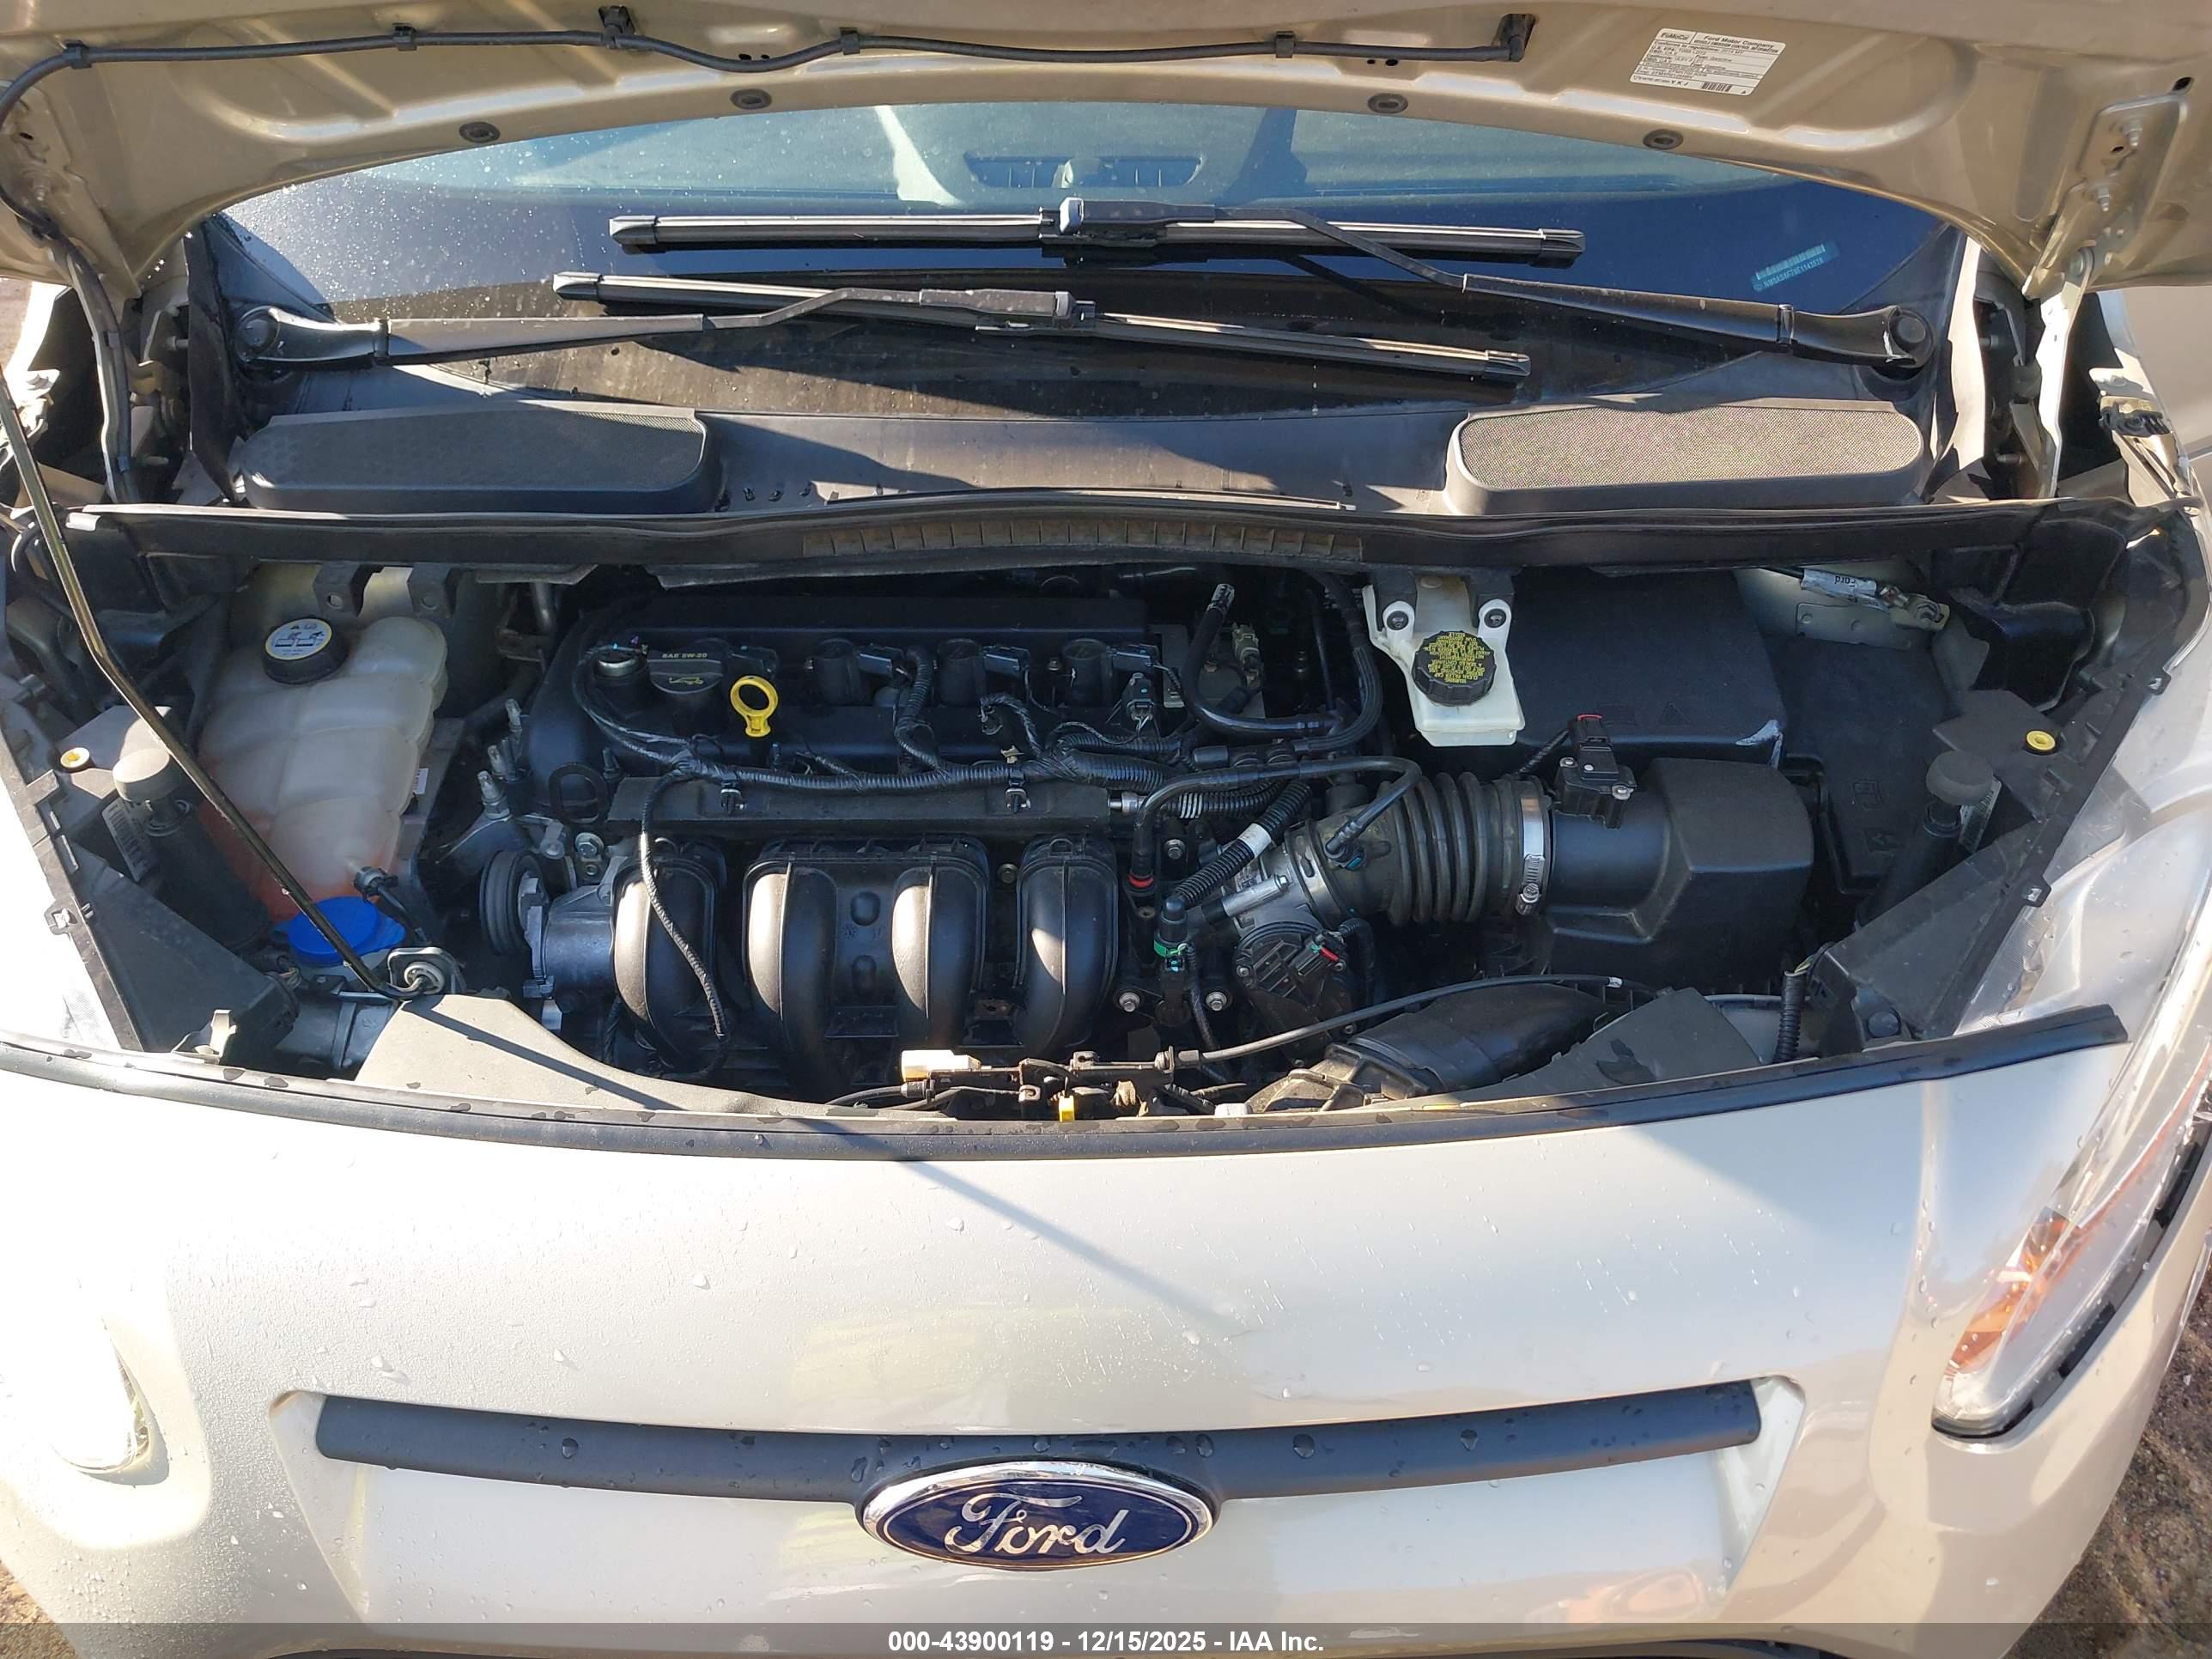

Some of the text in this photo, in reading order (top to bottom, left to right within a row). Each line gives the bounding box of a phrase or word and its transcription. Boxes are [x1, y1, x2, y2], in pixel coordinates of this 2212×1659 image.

[1721, 37, 1741, 46] Motor
[1742, 40, 1775, 50] Company
[945, 1492, 1129, 1555] Ford
